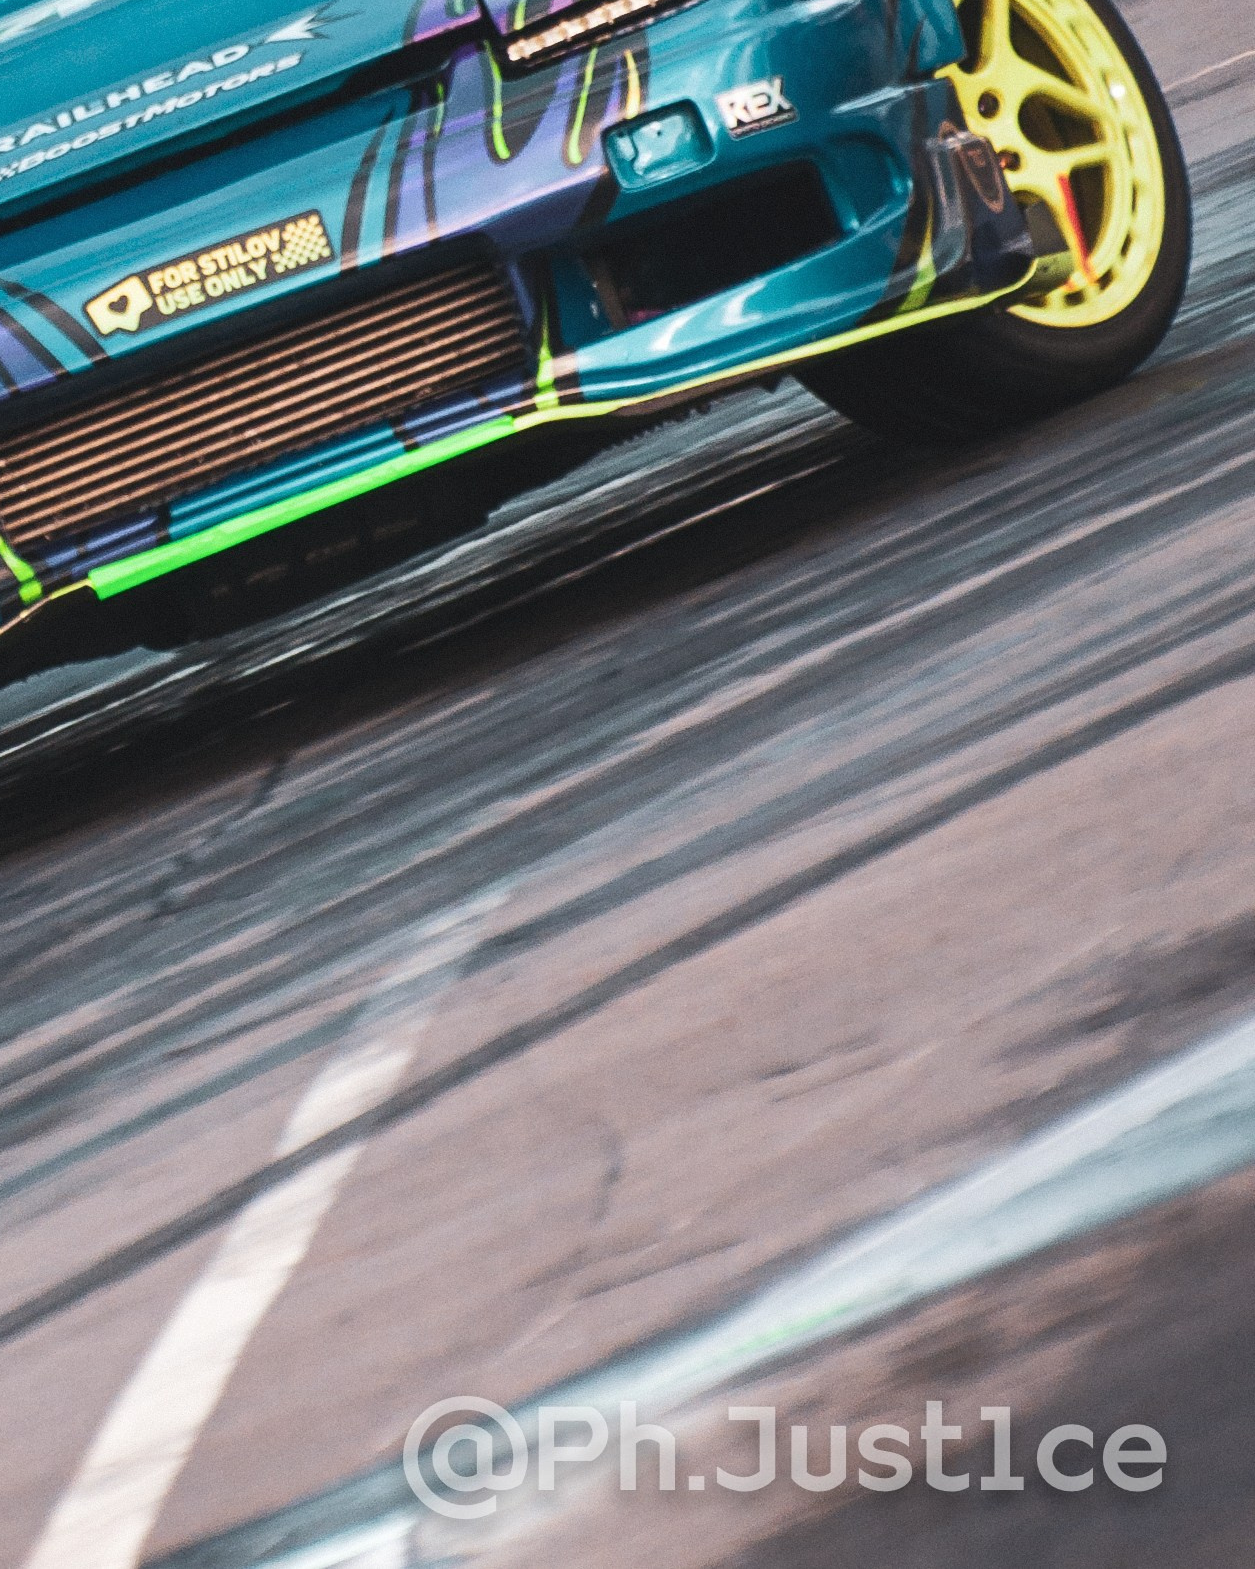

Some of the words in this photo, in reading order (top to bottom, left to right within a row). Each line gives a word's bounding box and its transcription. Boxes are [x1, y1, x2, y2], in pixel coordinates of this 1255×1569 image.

[716, 78, 793, 129] REX
[148, 260, 201, 295] FOR
[197, 229, 281, 276] STILOV
[154, 282, 206, 315] USE
[205, 257, 268, 297] ONLY
